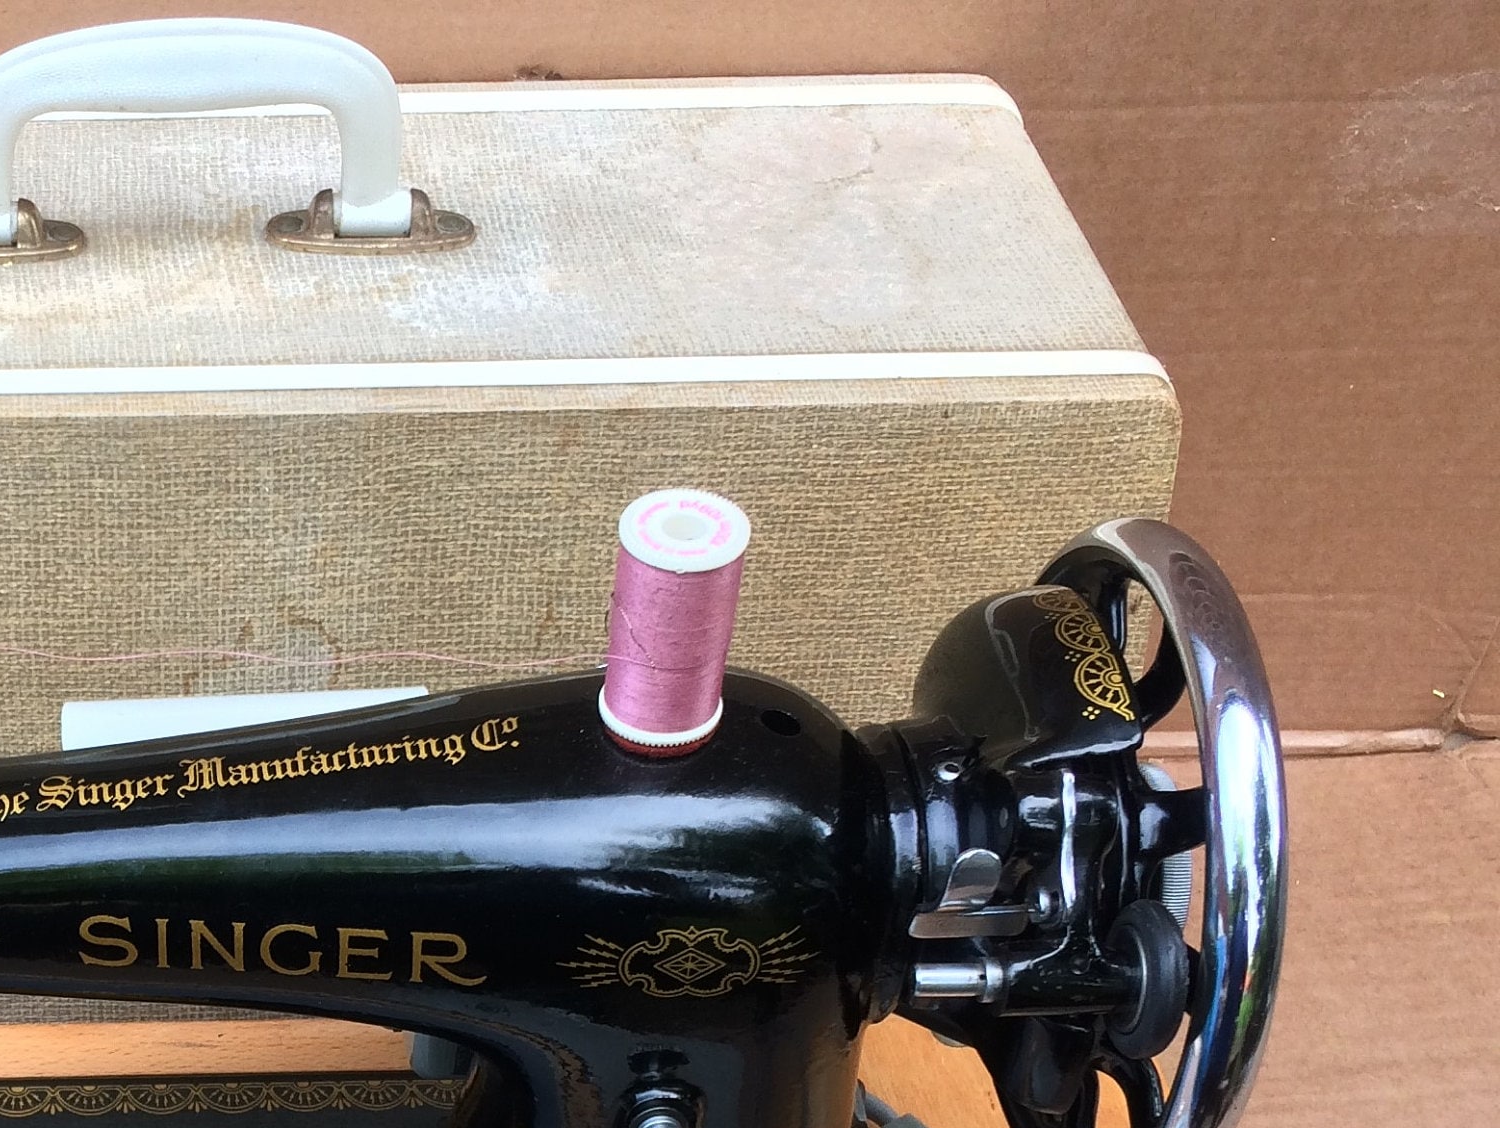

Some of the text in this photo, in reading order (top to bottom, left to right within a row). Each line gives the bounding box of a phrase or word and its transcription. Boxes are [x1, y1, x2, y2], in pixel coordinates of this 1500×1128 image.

[36, 774, 175, 812] Singer
[176, 733, 466, 799] Manufacturing
[77, 913, 489, 988] SINGER
